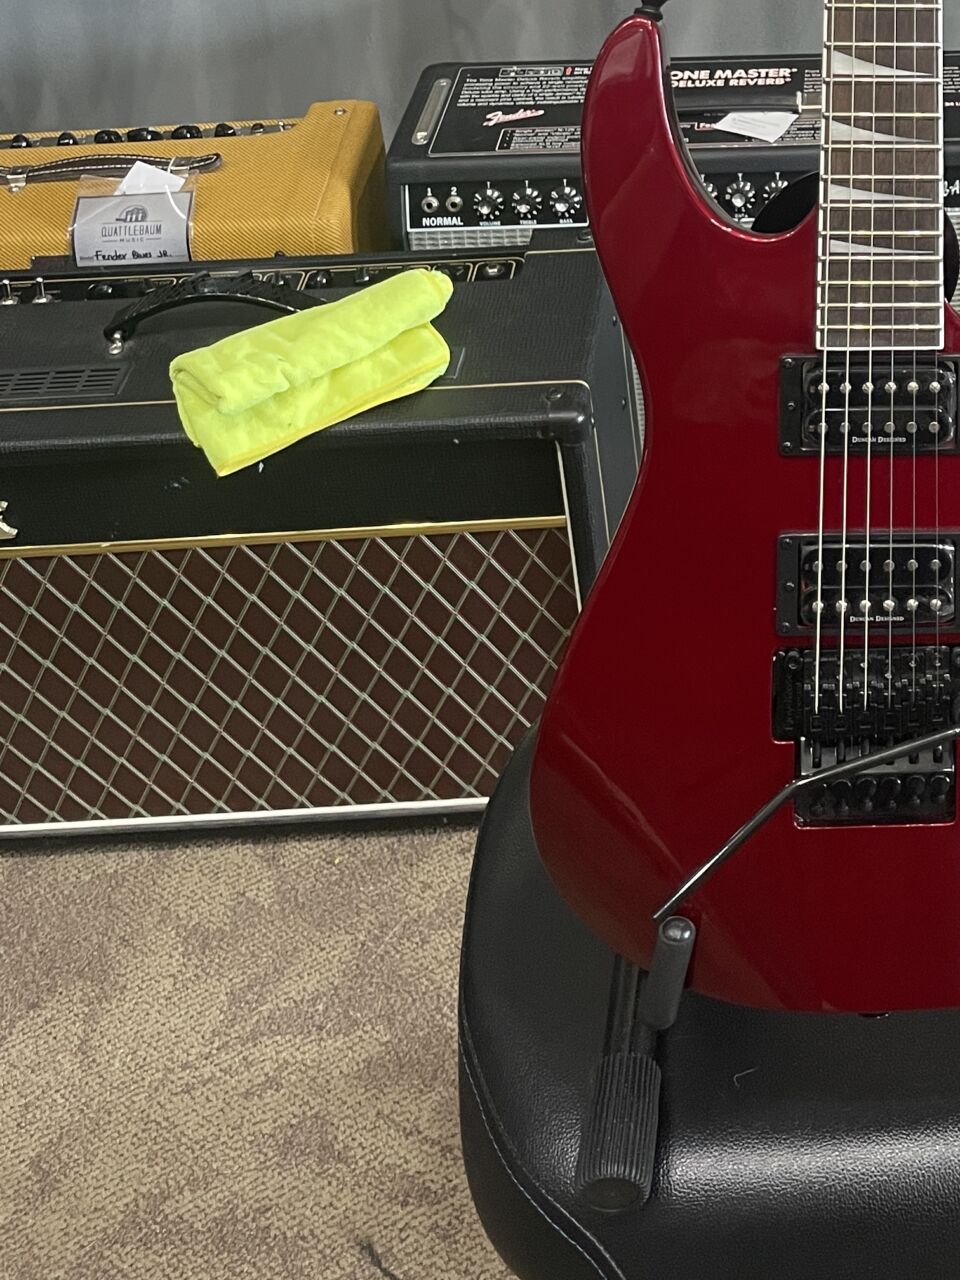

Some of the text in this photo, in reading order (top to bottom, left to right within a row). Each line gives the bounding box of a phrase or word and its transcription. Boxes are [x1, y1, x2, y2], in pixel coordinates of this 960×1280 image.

[671, 68, 790, 80] ONE MASTER
[671, 77, 784, 88] DELUXE REVERB
[482, 108, 545, 127] Fender
[427, 187, 457, 196] 1 2
[422, 217, 464, 227] NORMAL
[101, 224, 162, 238] QUATTLEBAUM
[94, 250, 127, 261] Fender
